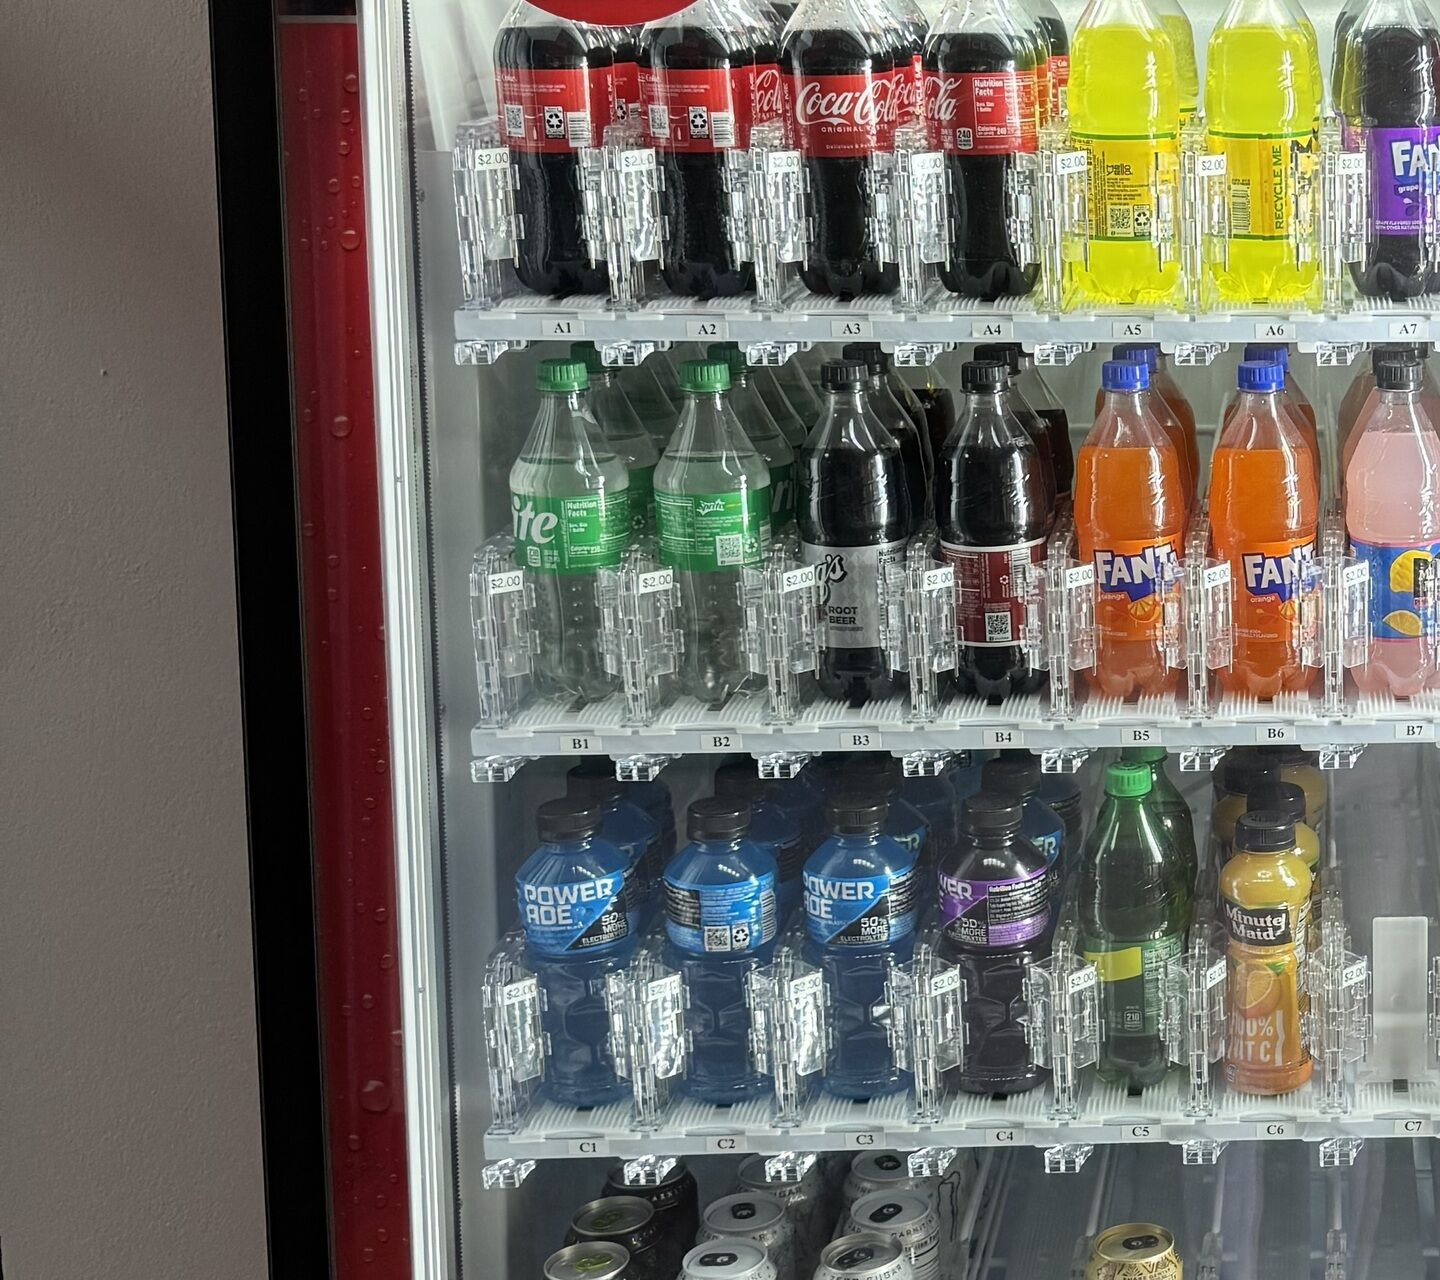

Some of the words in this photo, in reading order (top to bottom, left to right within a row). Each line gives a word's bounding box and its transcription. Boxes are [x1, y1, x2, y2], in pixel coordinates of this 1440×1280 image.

[975, 87, 994, 96] Facts
[821, 125, 864, 133] ORIGINAL
[957, 129, 971, 139] 240
[477, 152, 509, 166] $2.00
[1273, 144, 1283, 166] ME
[1060, 156, 1086, 169] $2.00
[1201, 158, 1225, 170] $2.00
[1342, 158, 1364, 170] $2.00
[1273, 168, 1284, 230] RECYCLE
[554, 322, 571, 334] A1
[698, 323, 717, 335] A2
[842, 323, 861, 335] A3
[983, 323, 1002, 335] A4
[1123, 324, 1142, 336] A5
[1266, 325, 1284, 336] A6
[1399, 324, 1418, 334] A7
[785, 571, 815, 586] $2.00
[925, 572, 953, 585] $2.00
[1068, 568, 1093, 582] $2.00
[1207, 567, 1230, 581] $2.00
[1345, 568, 1366, 582] $2.00
[491, 574, 521, 588] $2.00
[642, 574, 672, 587] $2.00
[1250, 594, 1276, 603] orange
[828, 605, 858, 615] ROOT
[829, 615, 857, 625] BEER
[1133, 729, 1150, 742] B5
[1267, 727, 1284, 739] B6
[1406, 724, 1423, 736] B7
[713, 735, 731, 748] B2
[852, 734, 870, 746] B3
[995, 731, 1012, 742] B4
[572, 737, 590, 750] B1
[524, 878, 614, 904] POWER
[526, 905, 573, 926] ADE
[861, 916, 887, 926] 50%
[1226, 904, 1286, 928] Minute
[603, 920, 627, 934] MORE
[861, 924, 888, 936] MORE
[961, 927, 987, 937] MORE
[1232, 923, 1280, 942] Maid
[1071, 971, 1095, 988] $2.00
[1344, 965, 1366, 982] $2.00
[932, 975, 960, 990] $2.00
[506, 984, 537, 1000] $2.00
[1259, 1040, 1271, 1063] C
[1132, 1125, 1150, 1137] C5
[1267, 1124, 1284, 1135] C6
[1404, 1120, 1422, 1131] C7
[856, 1134, 874, 1145] C3
[996, 1130, 1013, 1141] C4
[579, 1142, 597, 1153] C1
[717, 1138, 735, 1150] C2
